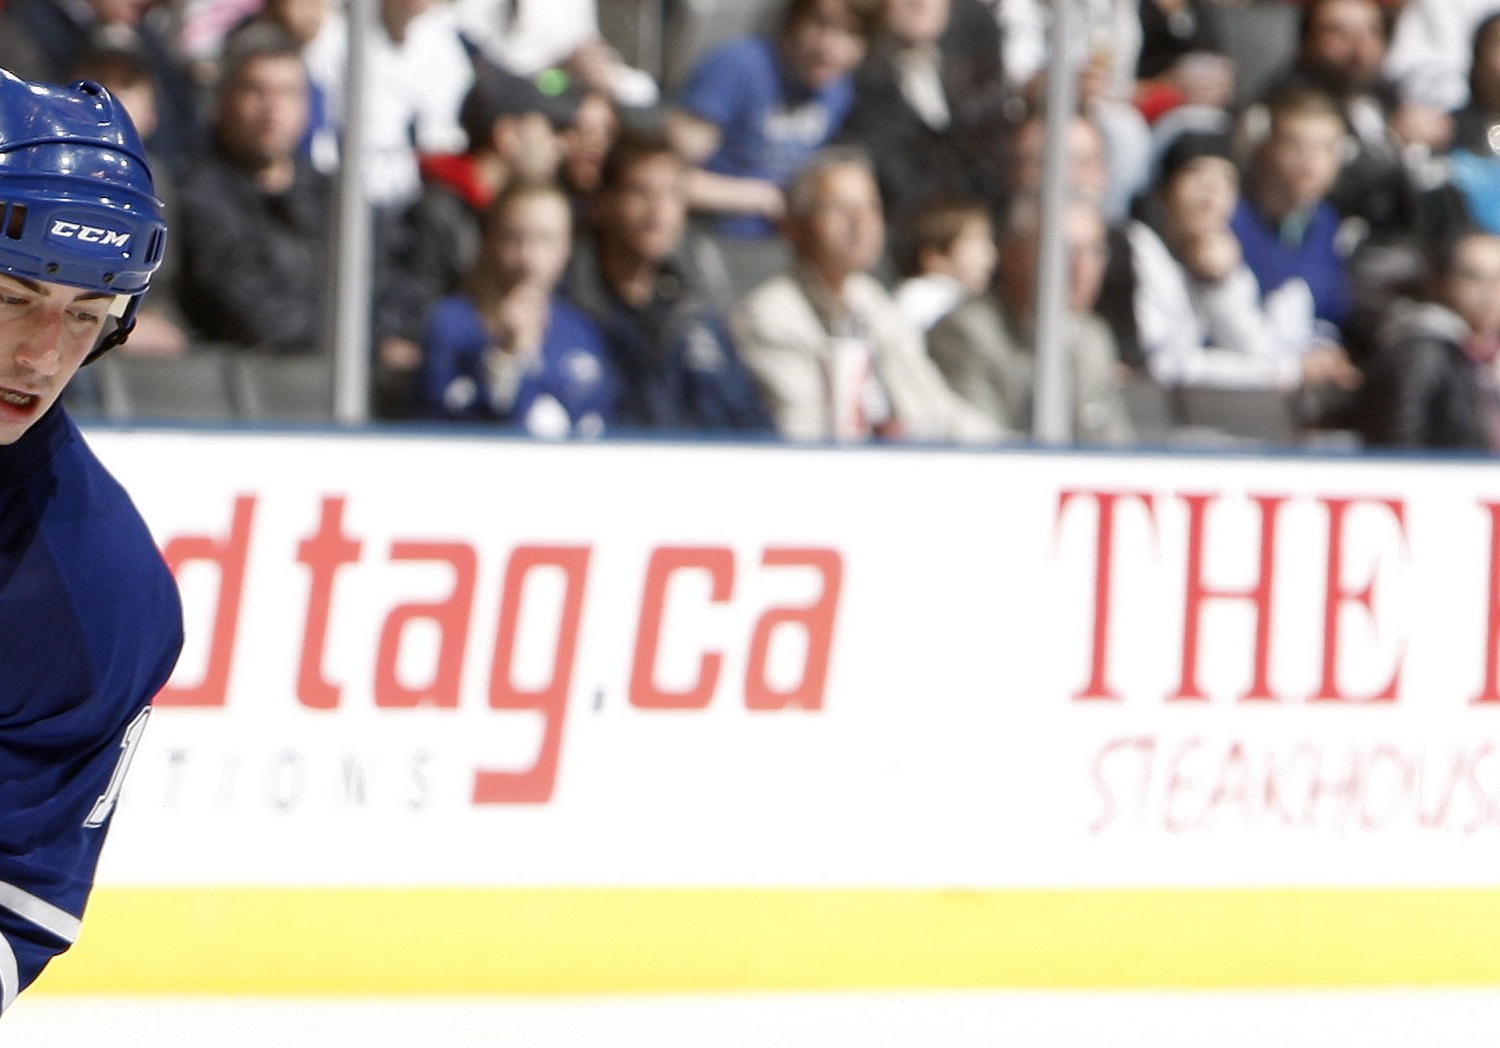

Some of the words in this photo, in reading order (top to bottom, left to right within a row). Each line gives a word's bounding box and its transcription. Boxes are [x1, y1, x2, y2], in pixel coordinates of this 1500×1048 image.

[51, 219, 131, 248] CCM
[1052, 484, 1413, 708] THE
[140, 748, 434, 814] TIONS
